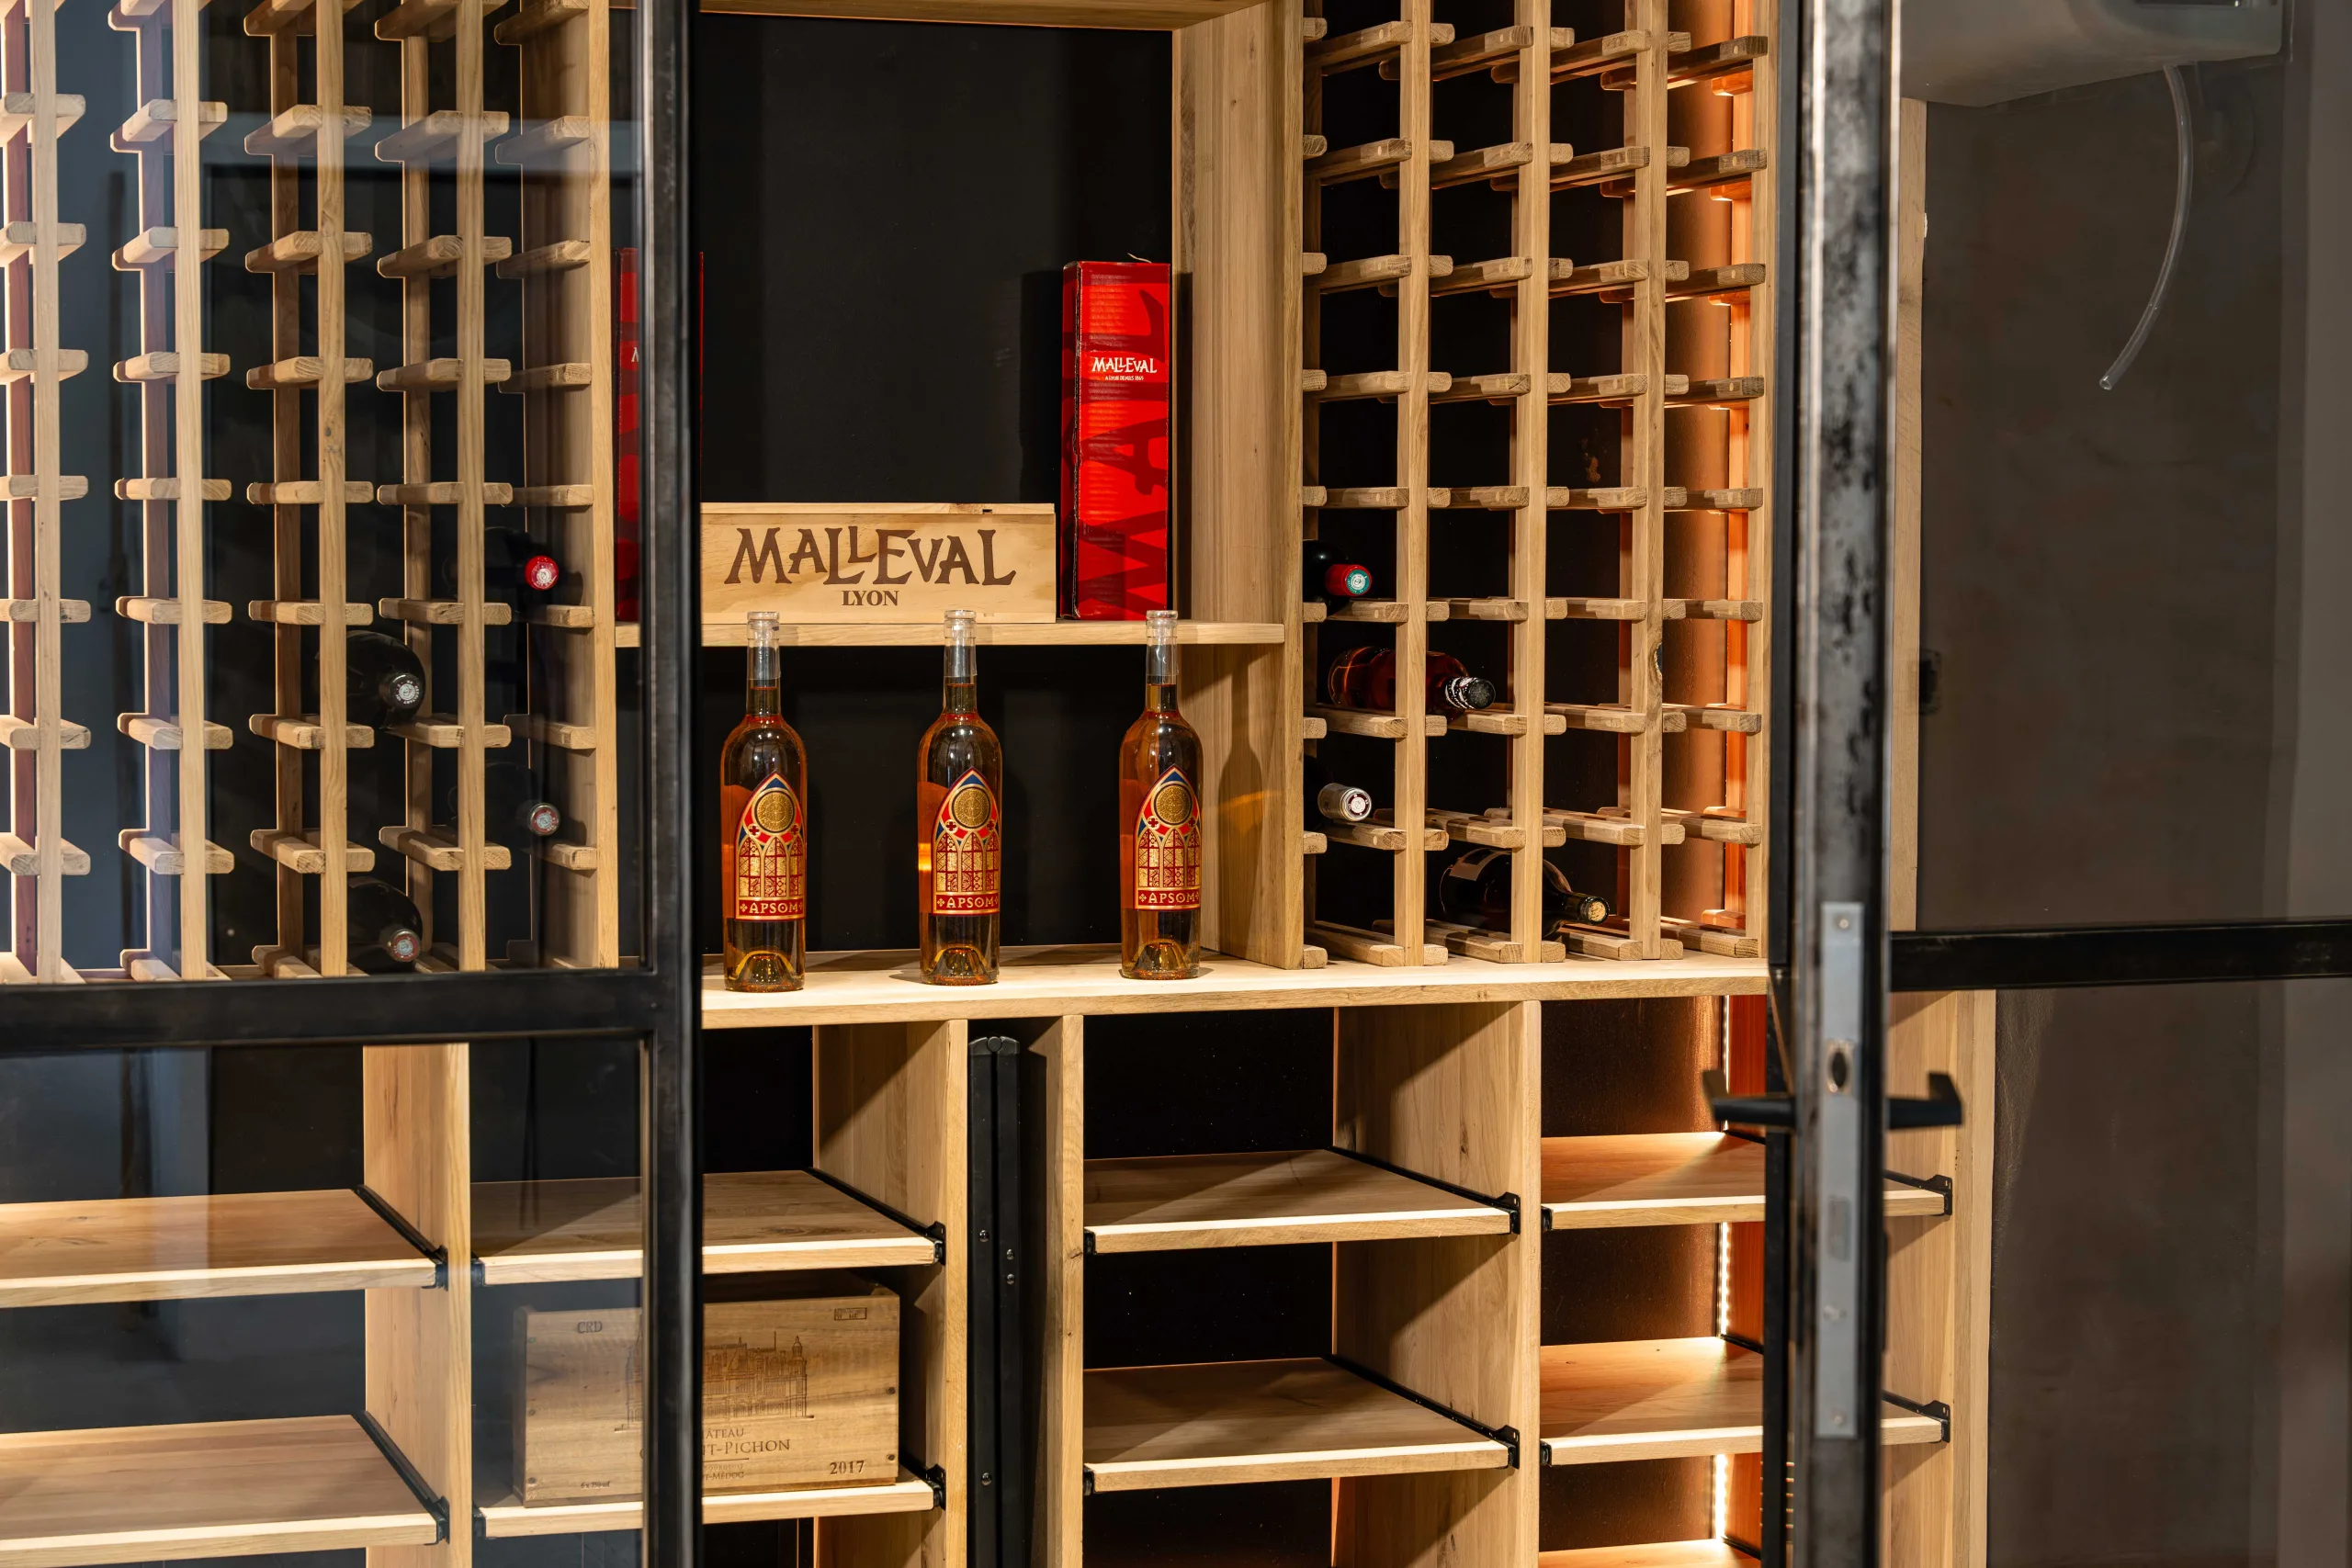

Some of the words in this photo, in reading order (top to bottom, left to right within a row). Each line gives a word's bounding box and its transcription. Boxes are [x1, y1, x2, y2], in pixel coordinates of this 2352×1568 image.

[1091, 356, 1158, 374] MALLEVAL
[724, 525, 1017, 586] MALLEVAL
[842, 590, 899, 606] LYON
[945, 896, 994, 908] APSOM
[1148, 892, 1195, 904] APSOM
[749, 902, 798, 914] APSOM
[577, 1320, 603, 1334] CRD
[706, 1427, 744, 1439] ÂTEAU
[701, 1438, 790, 1456] T-PICHON
[830, 1460, 865, 1475] 2017
[705, 1471, 744, 1481] T-MÉDOC
